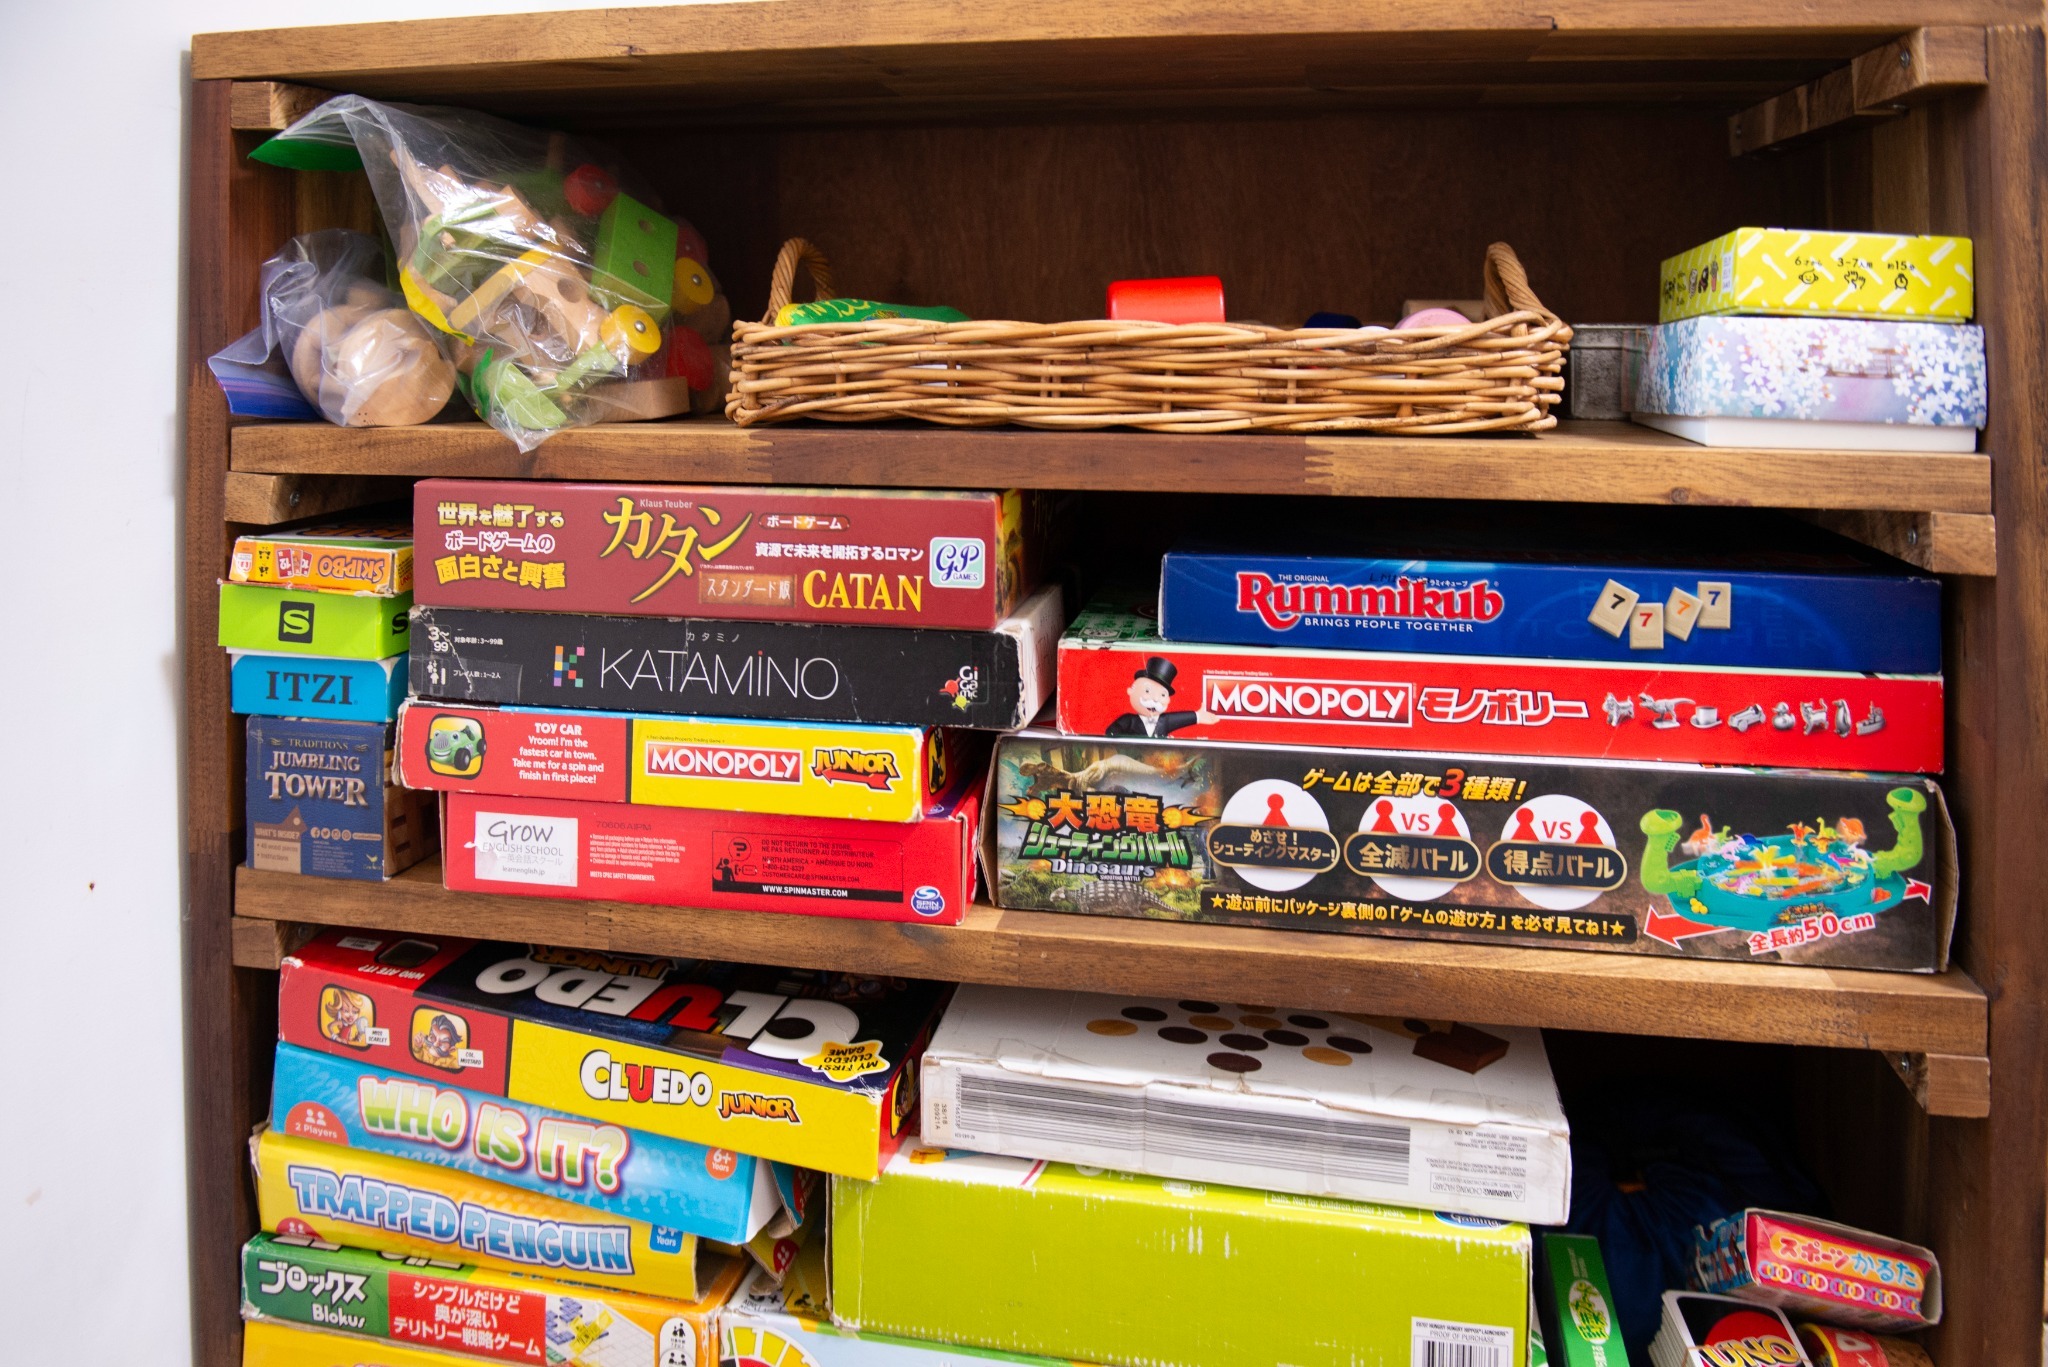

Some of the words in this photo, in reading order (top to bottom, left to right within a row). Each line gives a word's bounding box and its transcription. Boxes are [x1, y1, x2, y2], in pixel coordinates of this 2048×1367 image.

[437, 501, 564, 528] 世界を魅了する
[639, 499, 662, 509] Klaus
[664, 500, 693, 510] Teuber
[767, 515, 842, 530] ボードゲーム
[445, 531, 556, 553] ボードゲームの
[599, 497, 753, 603] カタン
[755, 542, 925, 562] 資源で未来を開拓するロマン
[434, 554, 566, 589] 面白さと興奮
[953, 573, 978, 581] GAMES
[1294, 574, 1330, 583] ORIGINAL
[707, 578, 791, 600] スタンダード版
[802, 569, 923, 612] CATAN
[1708, 590, 1721, 606] 7
[1236, 571, 1504, 631] Rummikub
[1610, 593, 1626, 609] 7
[1677, 600, 1691, 615] 7
[282, 608, 311, 636] S
[1304, 617, 1350, 628] BRINGS
[1355, 619, 1400, 630] PEOPLE
[1405, 621, 1474, 633] TOGETHER
[1639, 612, 1653, 627] 7
[433, 641, 449, 652] 99
[686, 631, 740, 643] カタミノ
[266, 671, 352, 705] ITZI
[1210, 682, 1406, 719] MONOPOLY
[1418, 686, 1590, 727] モノポリー
[534, 722, 557, 734] TOY
[559, 724, 582, 736] CAR
[288, 738, 349, 749] TRADITIONS
[528, 735, 559, 746] Vroom!
[560, 737, 573, 746] I'm
[573, 738, 588, 748] the
[269, 750, 361, 772] JUMBLING
[519, 746, 548, 757] fastest
[549, 750, 563, 758] car
[564, 749, 572, 759] in
[573, 750, 597, 760] town.
[650, 747, 799, 779] MONOPOLY
[812, 748, 899, 777] JUNIOR
[512, 757, 532, 768] Take
[533, 760, 546, 769] me
[547, 760, 560, 769] for
[568, 762, 586, 772] spin
[587, 763, 604, 772] and
[519, 769, 541, 780] finish
[542, 771, 550, 781] in
[551, 771, 569, 782] first
[569, 773, 597, 784] place!
[1302, 768, 1527, 802] ゲームは全部で3種類!
[265, 771, 369, 807] TOWER
[1047, 792, 1160, 832] 大恐竜
[1400, 812, 1431, 832] VS
[487, 820, 554, 845] Grow
[1250, 831, 1299, 845] めざせ!
[1542, 820, 1573, 840] VS
[482, 842, 523, 853] ENGLISH
[525, 845, 564, 857] SCHOOL
[1022, 822, 1190, 866] シューティングバトル
[1213, 841, 1337, 863] シューティングマスター!
[1051, 858, 1155, 877] Dinosaurs
[1359, 842, 1469, 873] 全滅バトル
[1503, 849, 1615, 879] 得点バトル
[762, 885, 848, 897] WWW.SPINMASTER.COM
[377, 966, 397, 977] ATE
[398, 970, 425, 981] WHO
[475, 957, 860, 1060] CLUEDO
[824, 1053, 873, 1064] CLUEDO
[828, 1046, 865, 1057] GAME
[817, 1064, 853, 1072] FIRST
[857, 1061, 878, 1071] MY
[580, 1049, 713, 1107] CLUEDO
[720, 1093, 800, 1122] JUNIOR
[295, 1122, 302, 1132] 2
[303, 1124, 338, 1139] Players
[360, 1078, 467, 1149] WHO
[475, 1103, 526, 1168] IS
[537, 1118, 629, 1192] IT?
[712, 1160, 730, 1172] Years
[713, 1148, 732, 1165] 6+
[1292, 1195, 1306, 1206] Not
[1307, 1197, 1318, 1208] for
[1320, 1198, 1350, 1211] children
[1353, 1203, 1375, 1214] under
[1382, 1207, 1406, 1219] years.
[289, 1165, 460, 1243] TRAPPED
[461, 1203, 634, 1275] PENGUIN
[656, 1235, 677, 1247] Years
[1777, 1235, 1921, 1289] スポーツかるた
[257, 1260, 371, 1305] ブロックス
[413, 1281, 521, 1315] シンプルだけど
[311, 1303, 366, 1329] Blokus
[435, 1303, 498, 1329] 奥が深い
[393, 1317, 541, 1358] テリトリー戦略ゲーム
[1430, 1330, 1450, 1340] PROOF
[1461, 1334, 1495, 1344] PURCHASE
[1699, 1335, 1800, 1367] UNO
